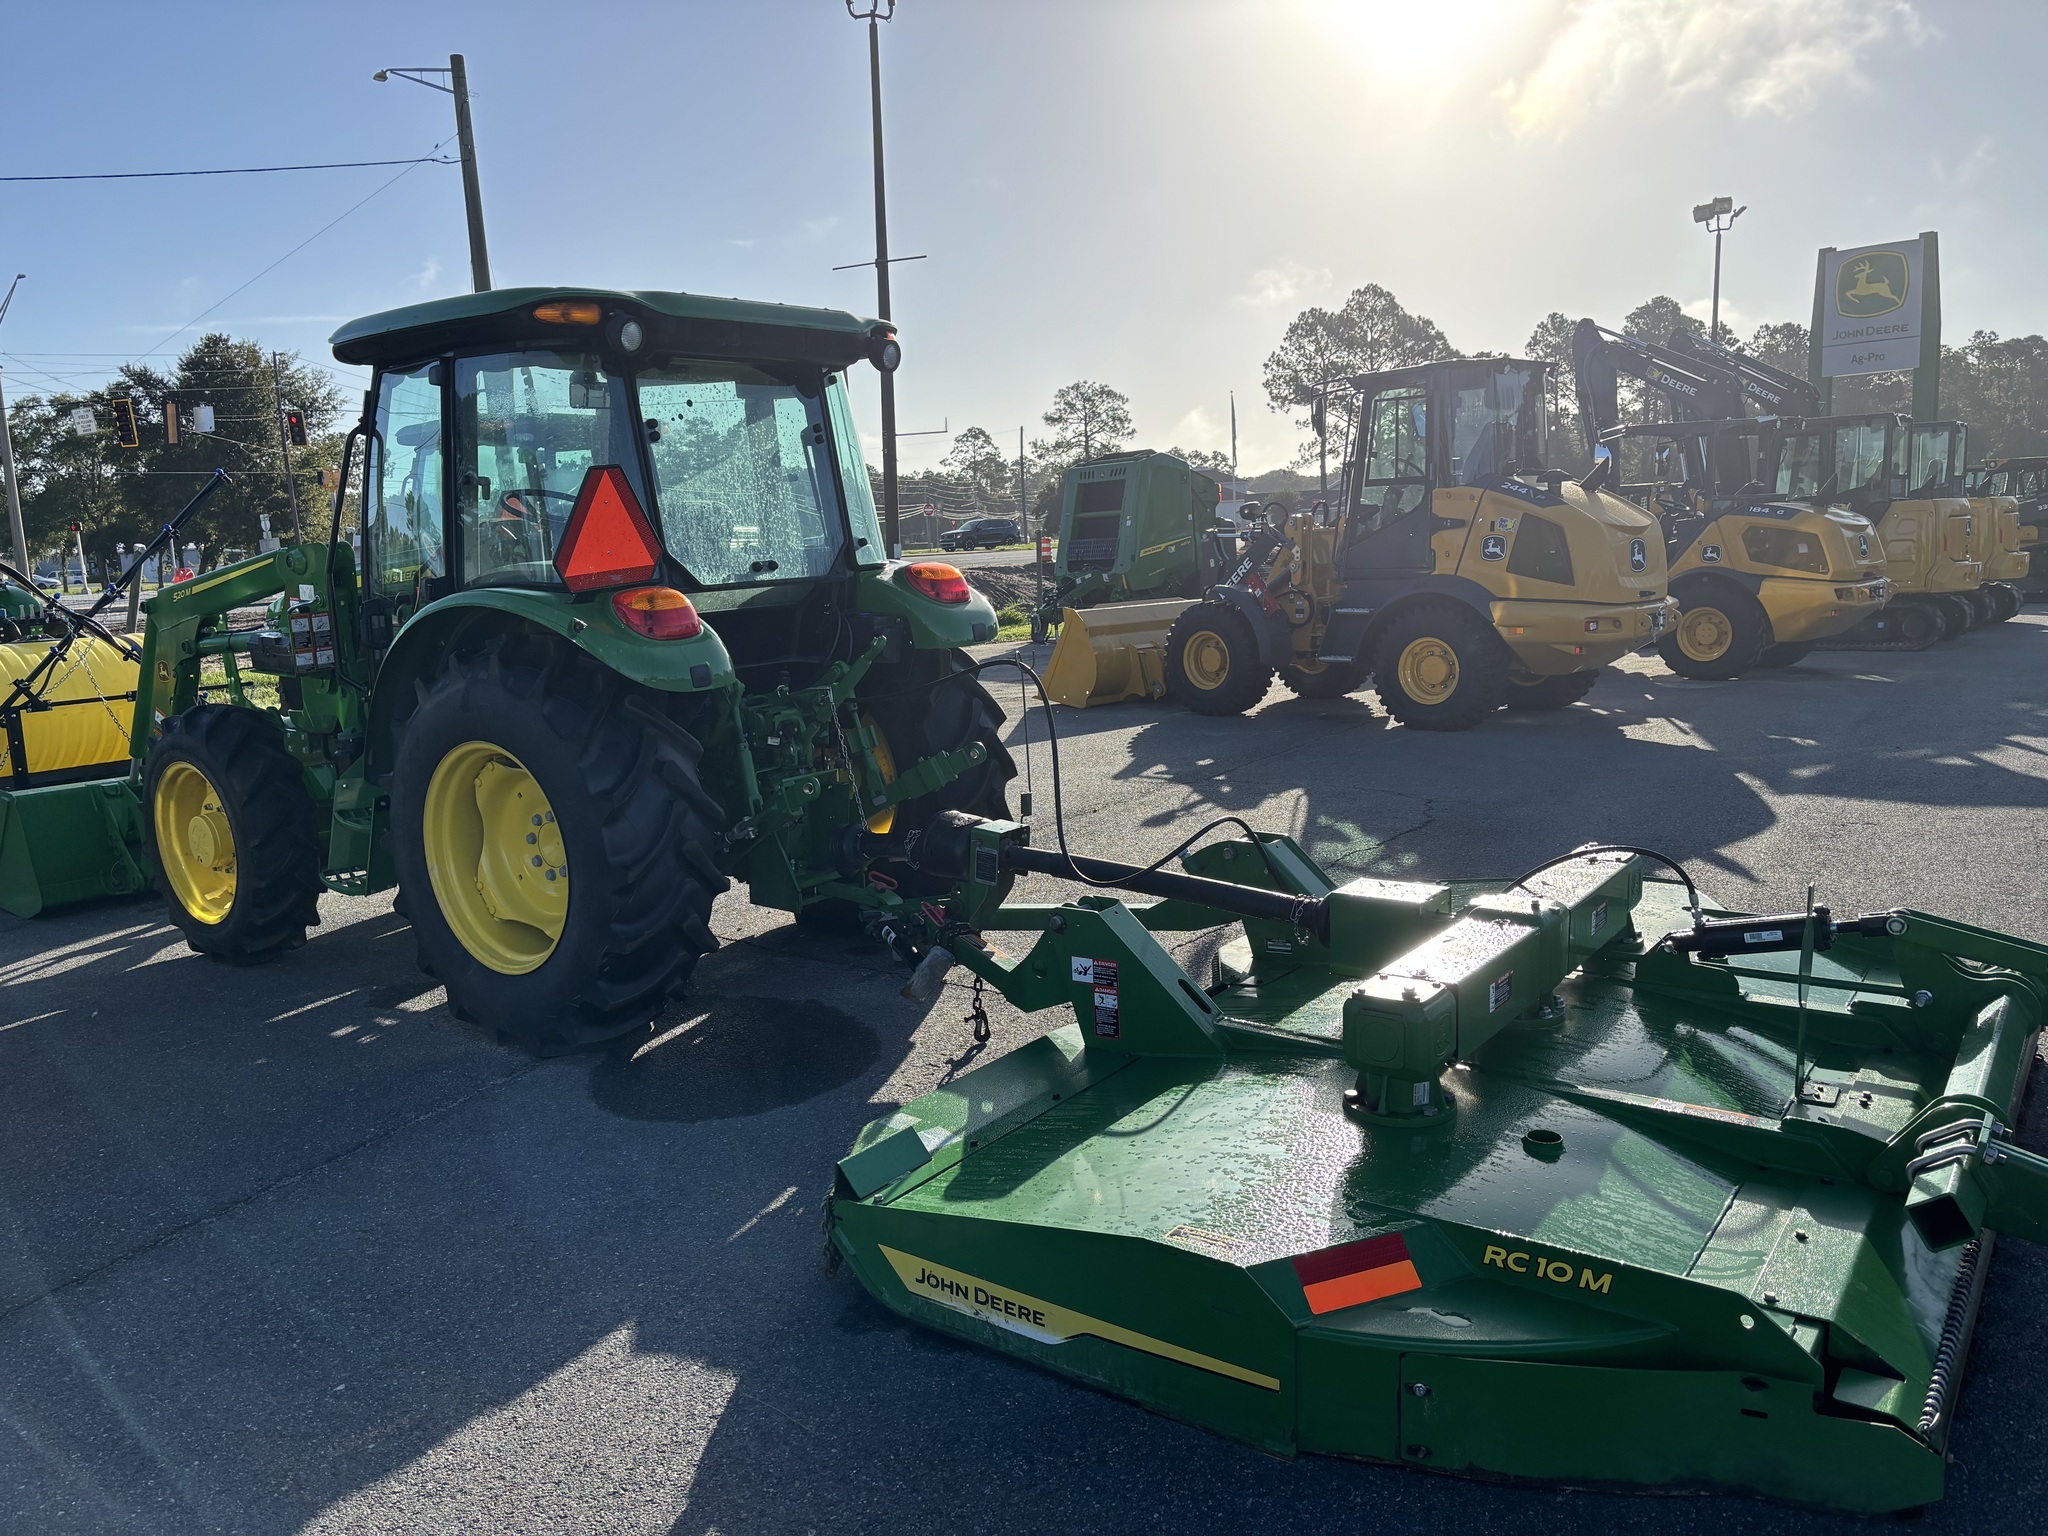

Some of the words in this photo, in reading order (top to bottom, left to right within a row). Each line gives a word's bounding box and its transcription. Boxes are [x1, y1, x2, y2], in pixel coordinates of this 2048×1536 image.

[1832, 329, 1864, 341] JOHN
[1866, 323, 1910, 337] DEERE
[1850, 352, 1886, 366] Ag-Pro
[1660, 373, 1698, 397] DEERE
[1747, 382, 1782, 405] DEERE
[1501, 481, 1529, 494] 244
[1749, 506, 1770, 514] 184
[1482, 1244, 1531, 1273] RC
[1535, 1256, 1575, 1283] 10
[1578, 1267, 1613, 1294] M
[915, 1267, 969, 1300] JOHN
[974, 1285, 1046, 1328] DEERE
